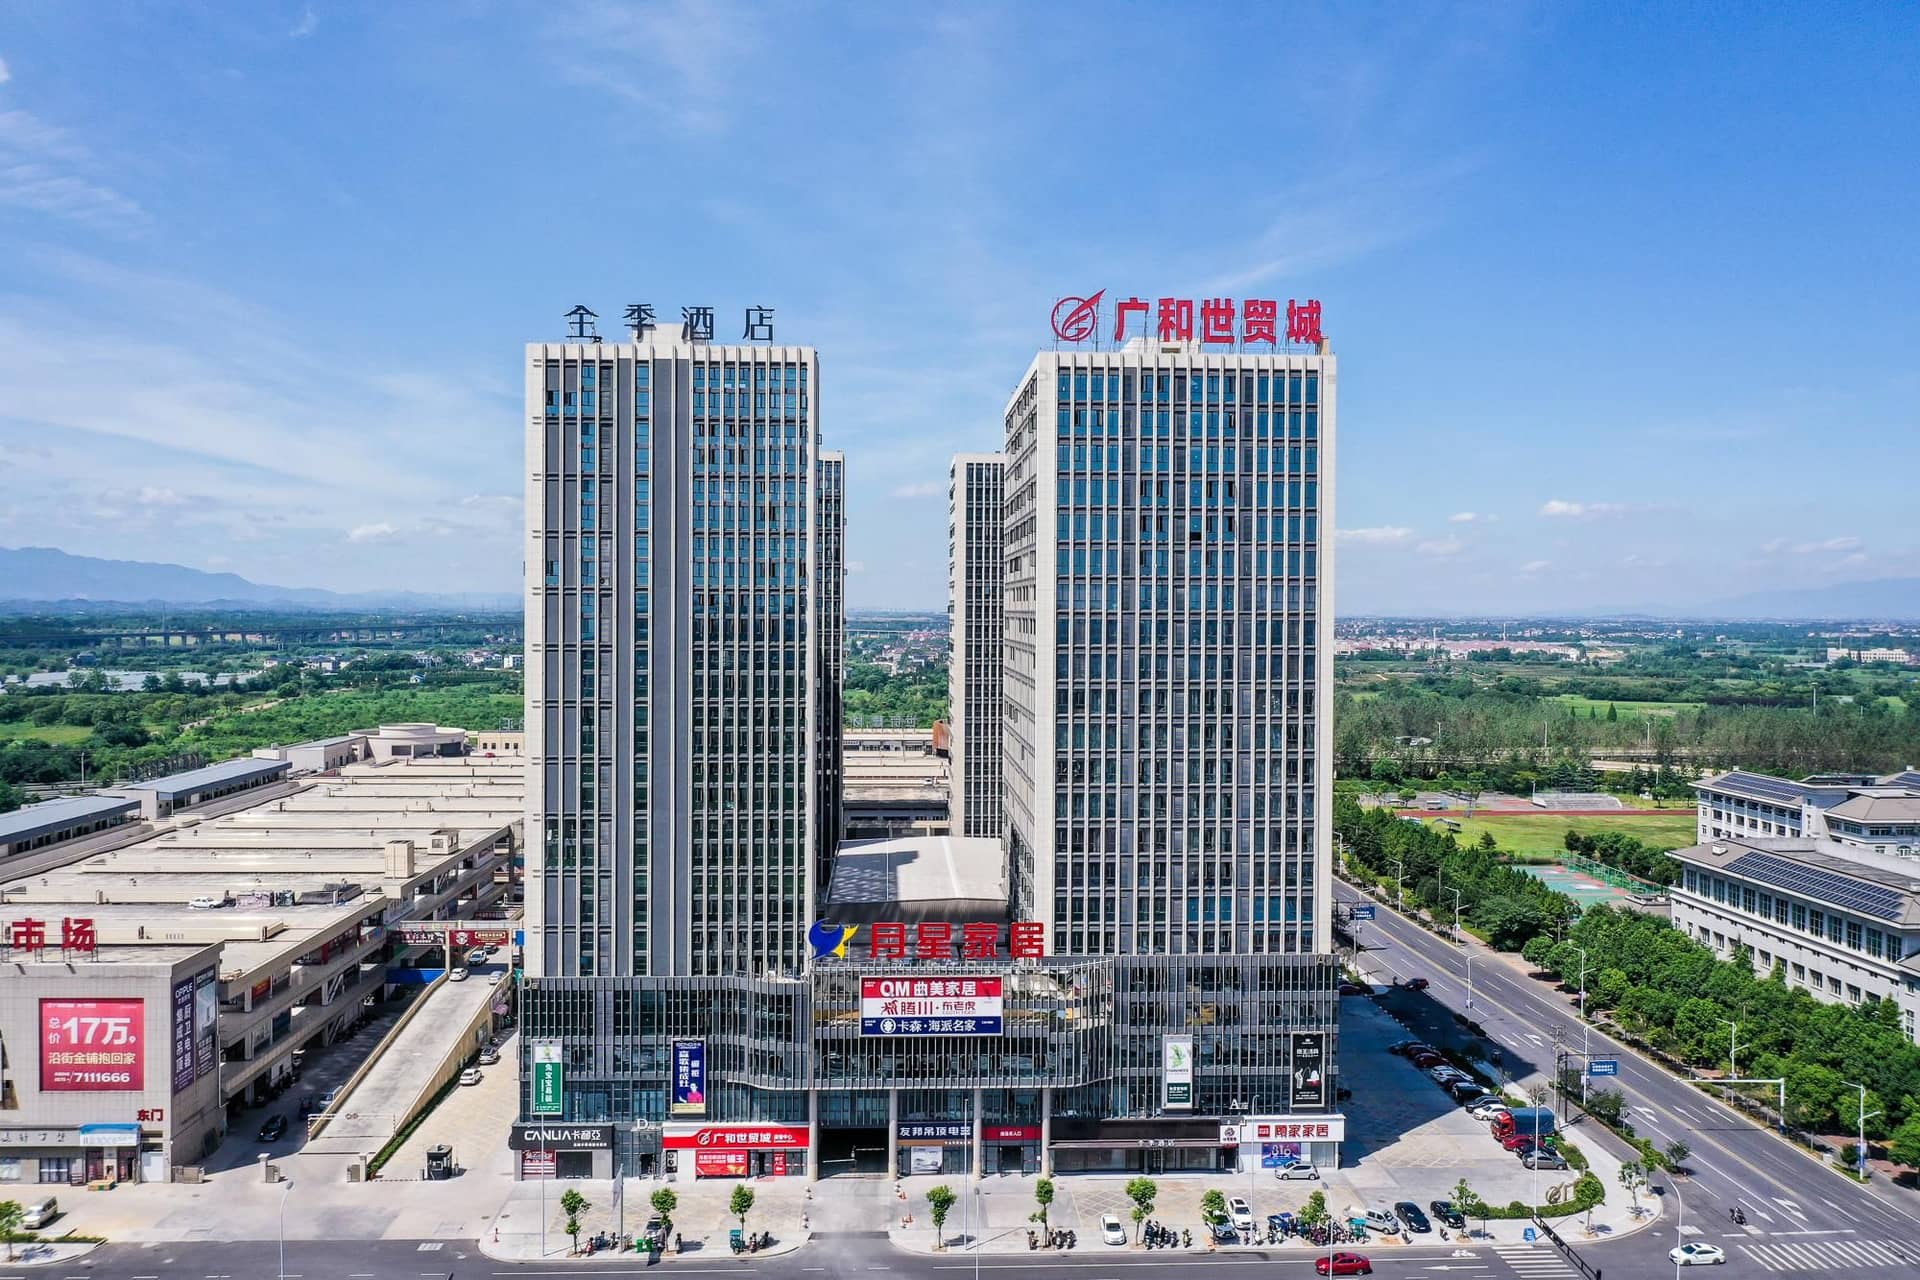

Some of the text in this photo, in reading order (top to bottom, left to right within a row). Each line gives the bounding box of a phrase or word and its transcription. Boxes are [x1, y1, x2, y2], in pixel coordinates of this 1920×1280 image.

[564, 303, 775, 344] 全季酒店
[1114, 297, 1321, 344] 广和世贸城
[12, 917, 95, 952] 市场
[869, 922, 1044, 959] 月星家居
[176, 982, 193, 998] OPPLE
[880, 981, 977, 997] QM 曲美家居
[48, 1052, 136, 1064] 沿街金铺抱回家
[74, 1072, 130, 1083] 7111666
[137, 1109, 163, 1121] 东门
[524, 1130, 571, 1141] CANLIA
[713, 1132, 772, 1144] 广和世贸城
[1275, 1124, 1329, 1138] 顾家家居
